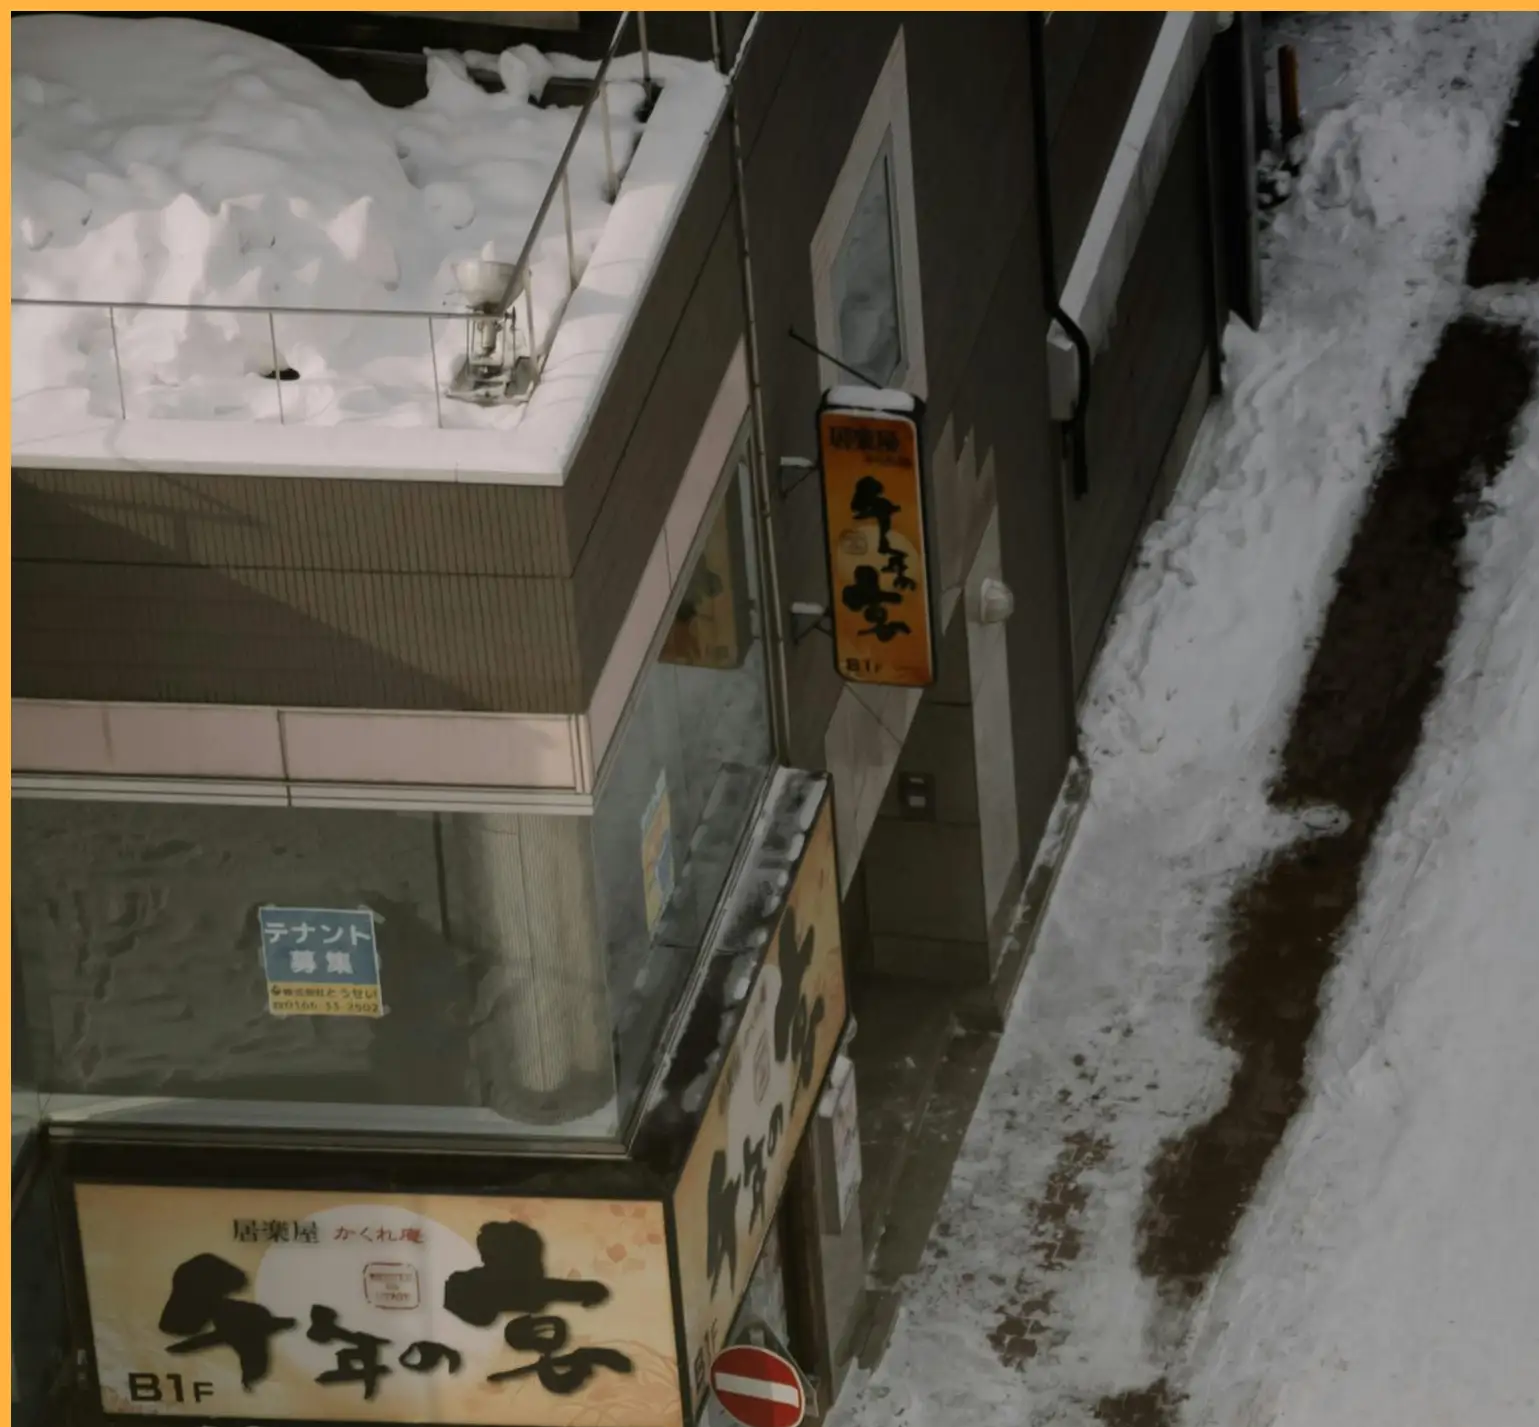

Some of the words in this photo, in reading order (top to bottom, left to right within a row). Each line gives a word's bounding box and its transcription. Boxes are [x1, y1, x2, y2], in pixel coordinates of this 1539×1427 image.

[264, 921, 372, 946] テナント
[232, 1218, 321, 1244] 居楽屋
[157, 1219, 632, 1400] 千年の宴
[128, 1371, 214, 1405] B1F
